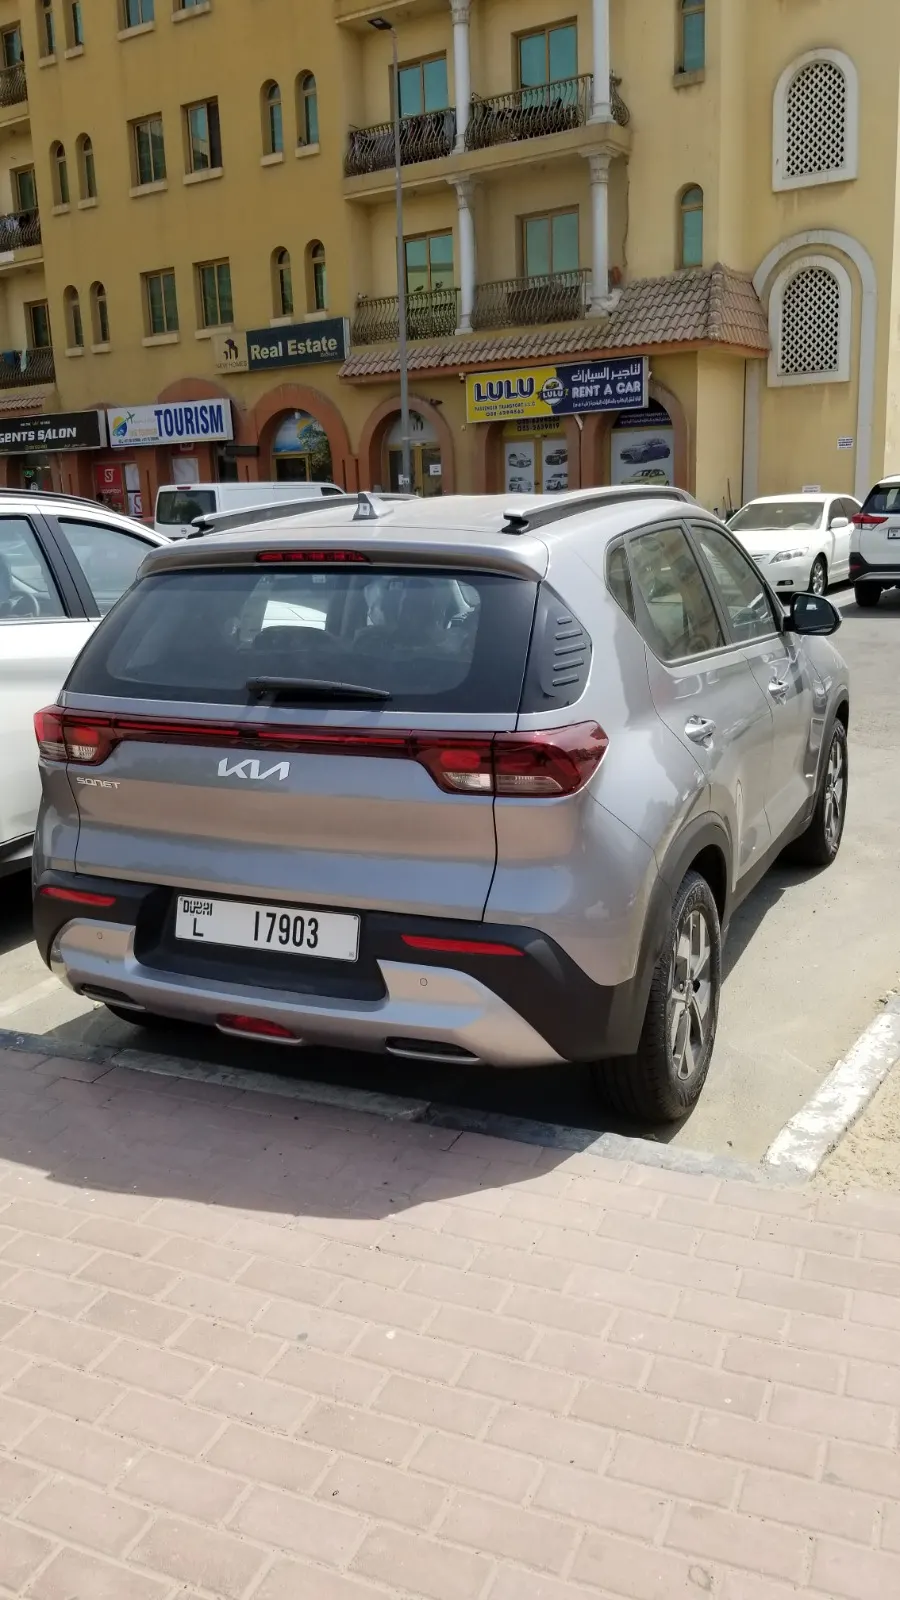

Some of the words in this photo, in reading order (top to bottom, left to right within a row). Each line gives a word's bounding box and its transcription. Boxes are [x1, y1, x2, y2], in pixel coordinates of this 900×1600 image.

[251, 344, 283, 360] Real
[287, 336, 337, 356] Estate
[228, 360, 248, 369] HOMES
[571, 367, 609, 383] السيارات
[474, 377, 535, 402] LULU
[542, 390, 564, 399] LULU
[571, 385, 600, 399] RENT
[603, 383, 613, 396] A
[616, 381, 641, 394] CAR
[498, 402, 524, 410] TRANSPORT
[154, 404, 224, 437] TOURISM
[37, 427, 77, 443] SALON
[218, 757, 290, 781] KIA
[76, 776, 121, 789] SONET
[192, 917, 204, 937] L
[254, 910, 319, 949] 17903
